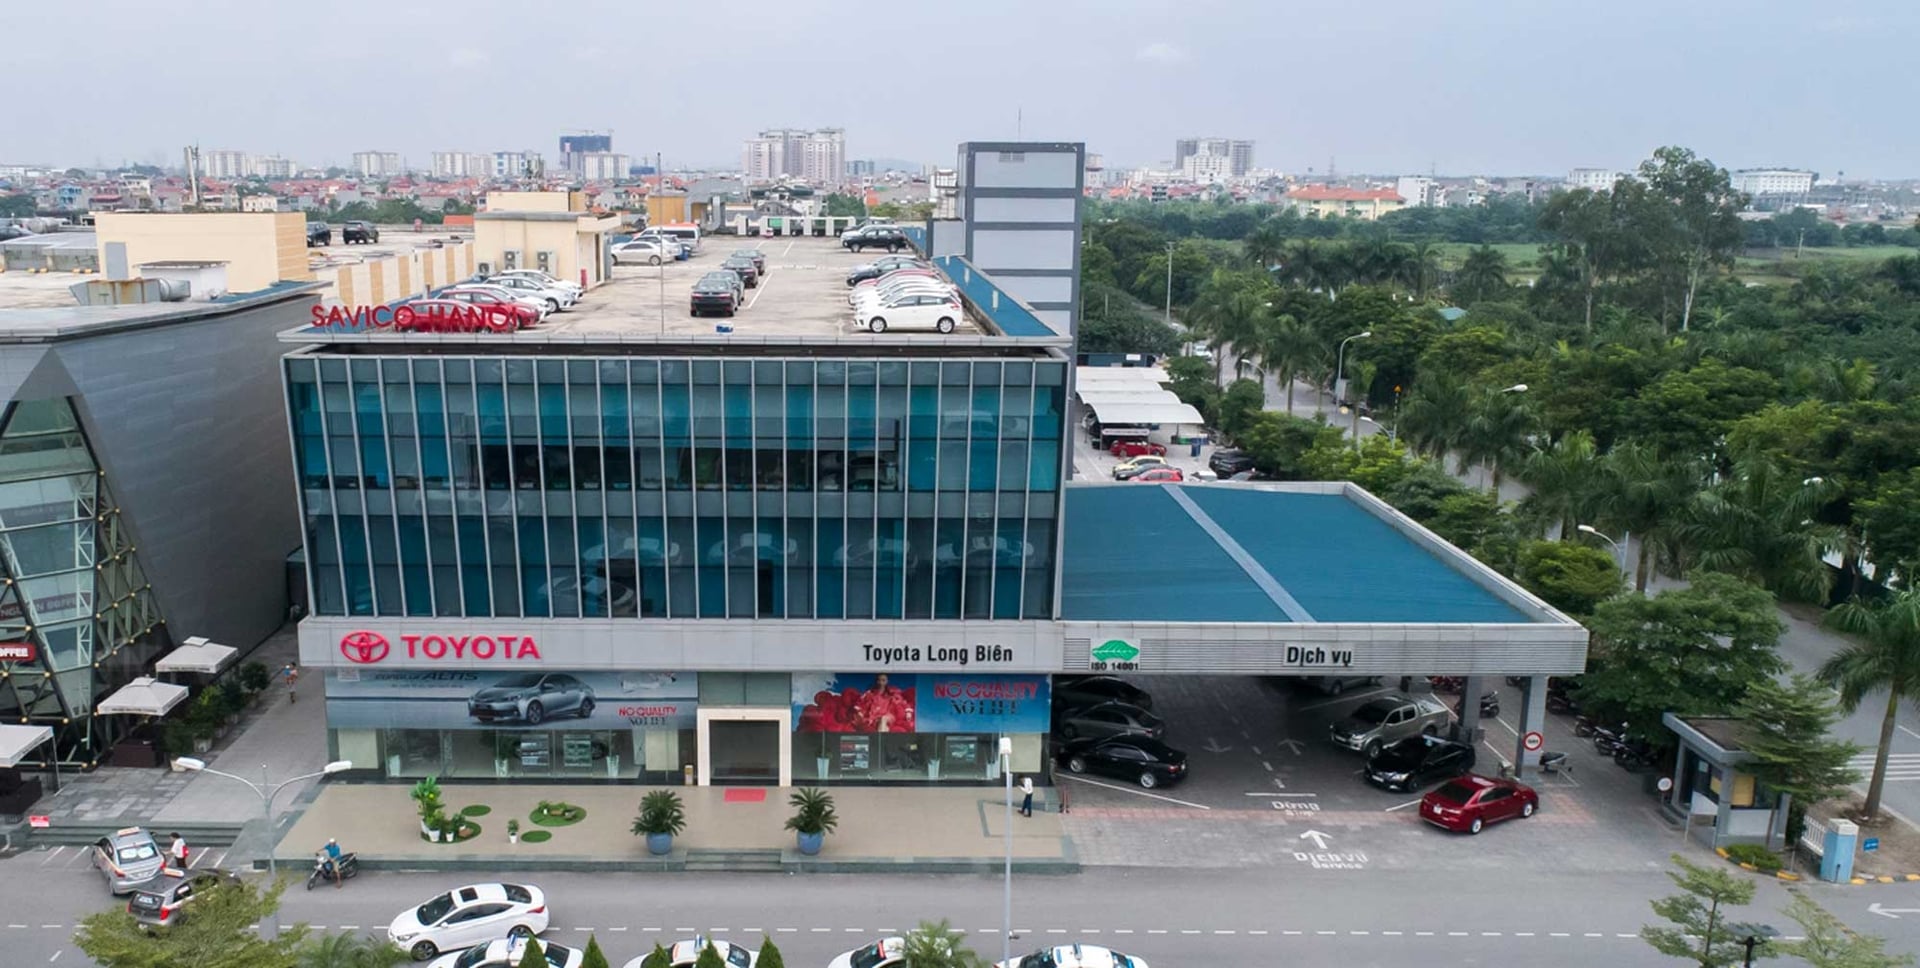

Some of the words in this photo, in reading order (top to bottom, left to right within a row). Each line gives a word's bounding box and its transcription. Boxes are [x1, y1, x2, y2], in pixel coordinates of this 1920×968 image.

[311, 305, 416, 328] SAVICO
[428, 305, 517, 329] HANOI
[401, 636, 541, 659] TOYOTA
[863, 645, 921, 664] Toyota
[928, 645, 968, 665] Long
[976, 645, 1013, 661] Biên
[1287, 646, 1325, 667] Dịch
[1332, 650, 1352, 667] vụ
[1091, 662, 1107, 670] ISO
[1112, 662, 1138, 670] 14001
[934, 682, 962, 698] NO
[966, 682, 1038, 699] QUALITY
[618, 706, 634, 716] NO
[636, 705, 677, 716] QUALITY
